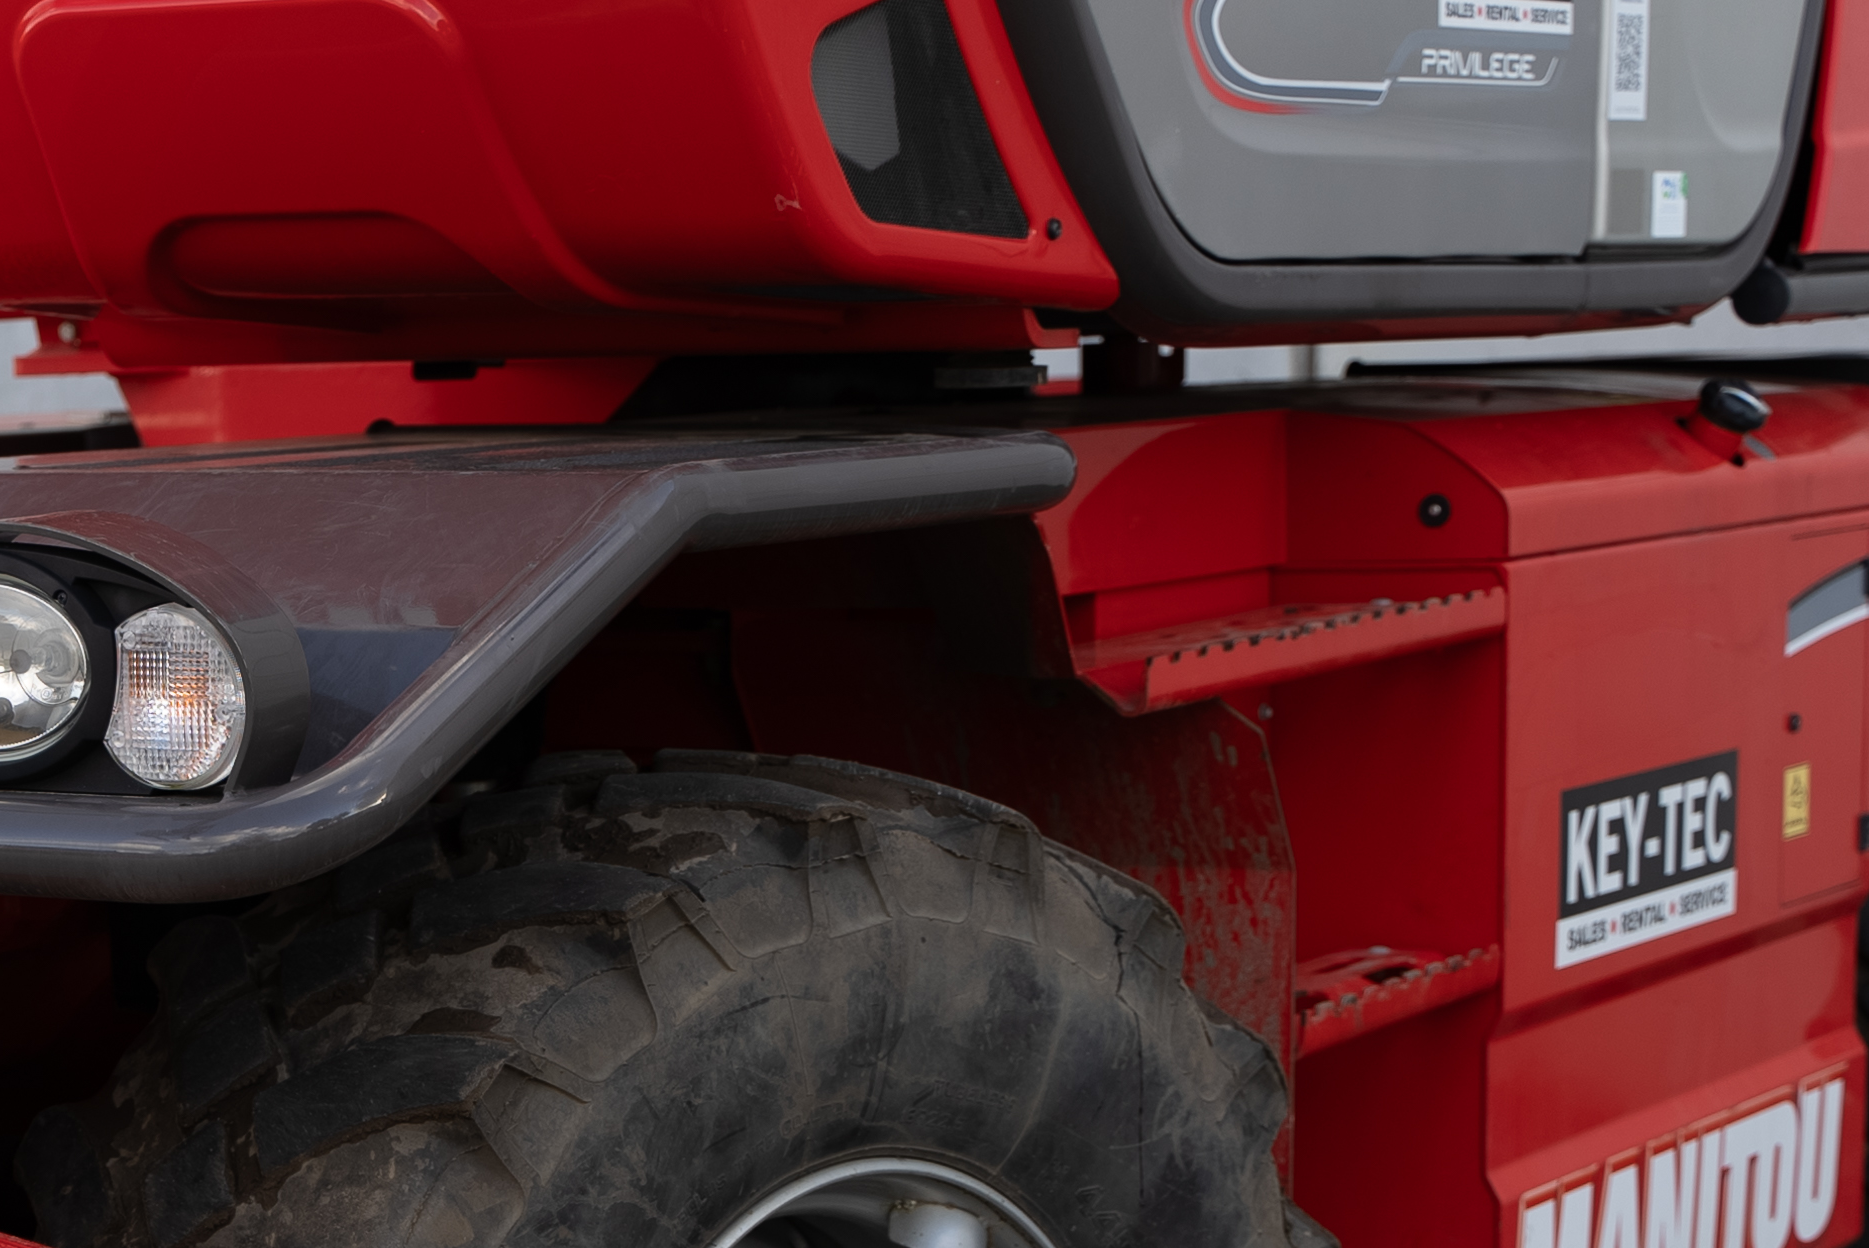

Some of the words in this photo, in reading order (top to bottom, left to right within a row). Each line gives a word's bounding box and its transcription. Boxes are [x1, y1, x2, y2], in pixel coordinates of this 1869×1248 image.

[1445, 2, 1476, 19] SALES
[1485, 4, 1521, 23] RENTAL
[1530, 7, 1569, 26] SERVICE
[1420, 48, 1536, 80] PRIVILEGE
[1566, 771, 1733, 904] KEY-TEC
[1567, 918, 1608, 950] SALES
[1620, 902, 1666, 935] RENTAL
[1679, 882, 1729, 917] SERVICE
